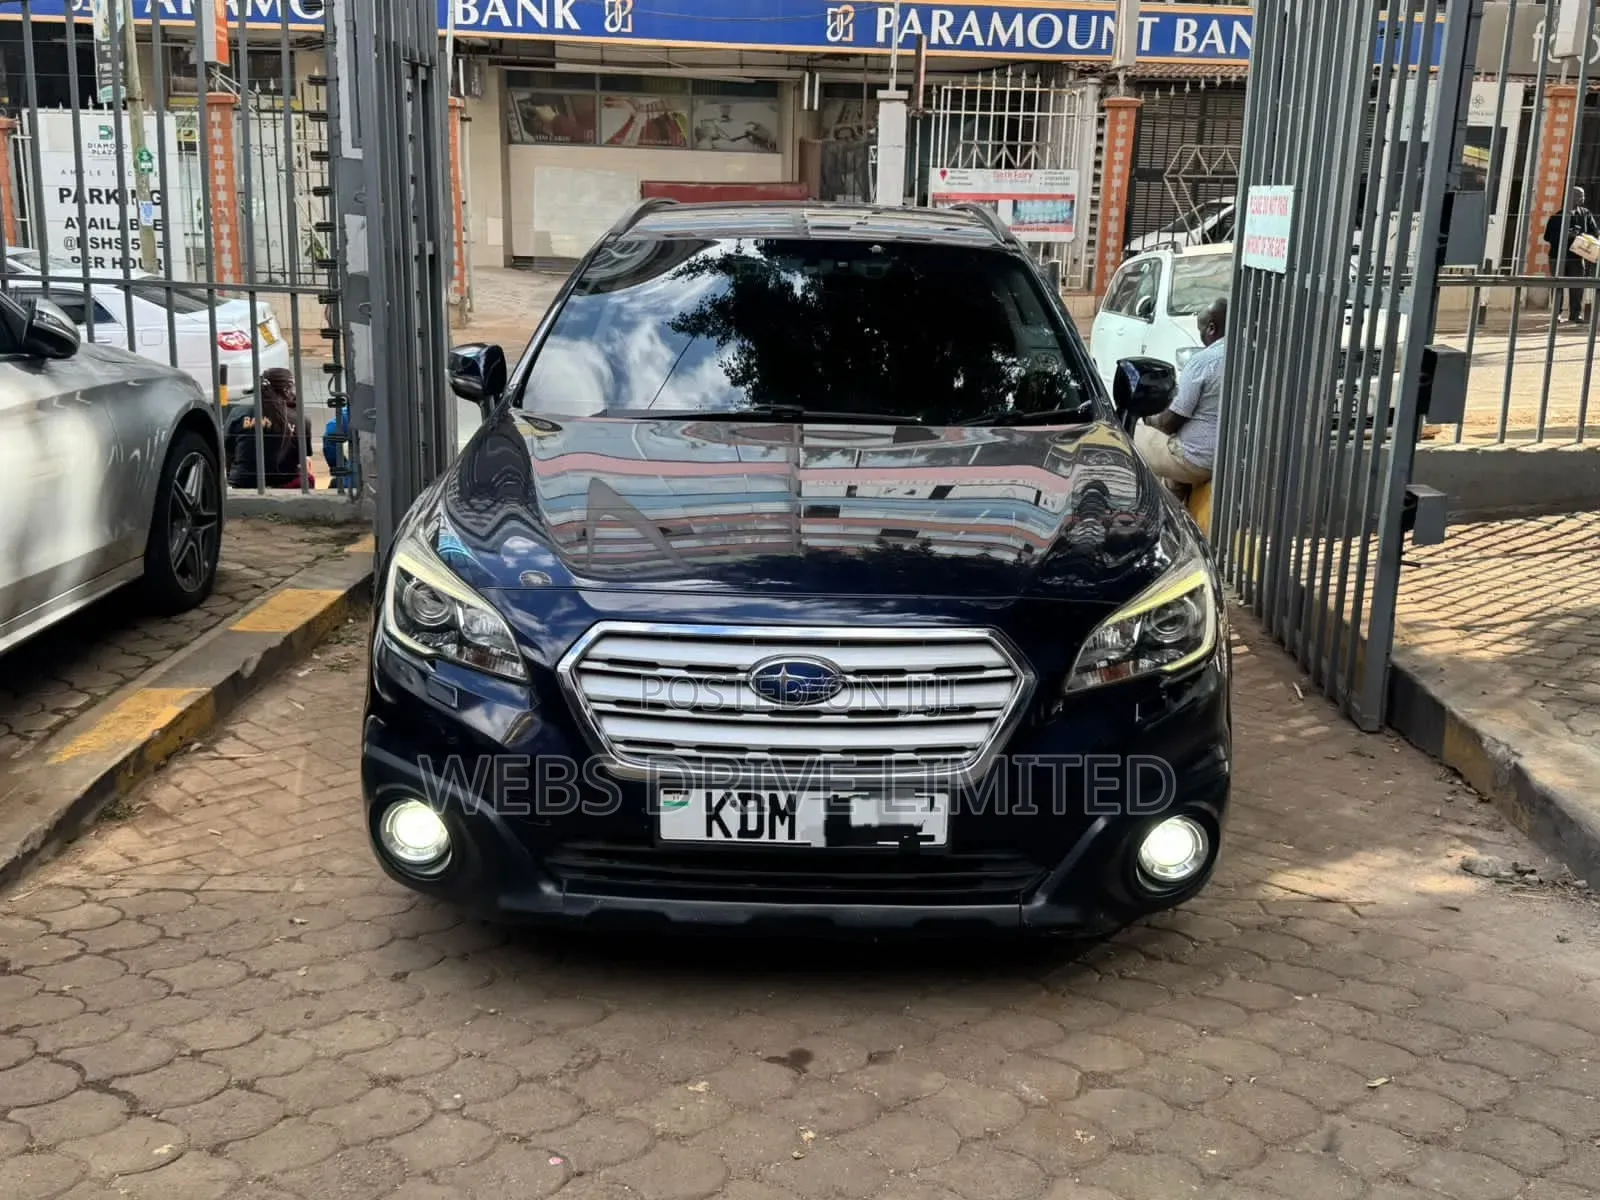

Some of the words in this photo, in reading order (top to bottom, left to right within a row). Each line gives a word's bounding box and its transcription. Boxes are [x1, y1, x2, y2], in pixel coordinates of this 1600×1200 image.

[454, 0, 581, 31] BANK
[1174, 18, 1252, 54] BAN
[88, 142, 128, 150] DIAMOD
[58, 187, 161, 205] PARKG
[705, 791, 796, 840] KDM
